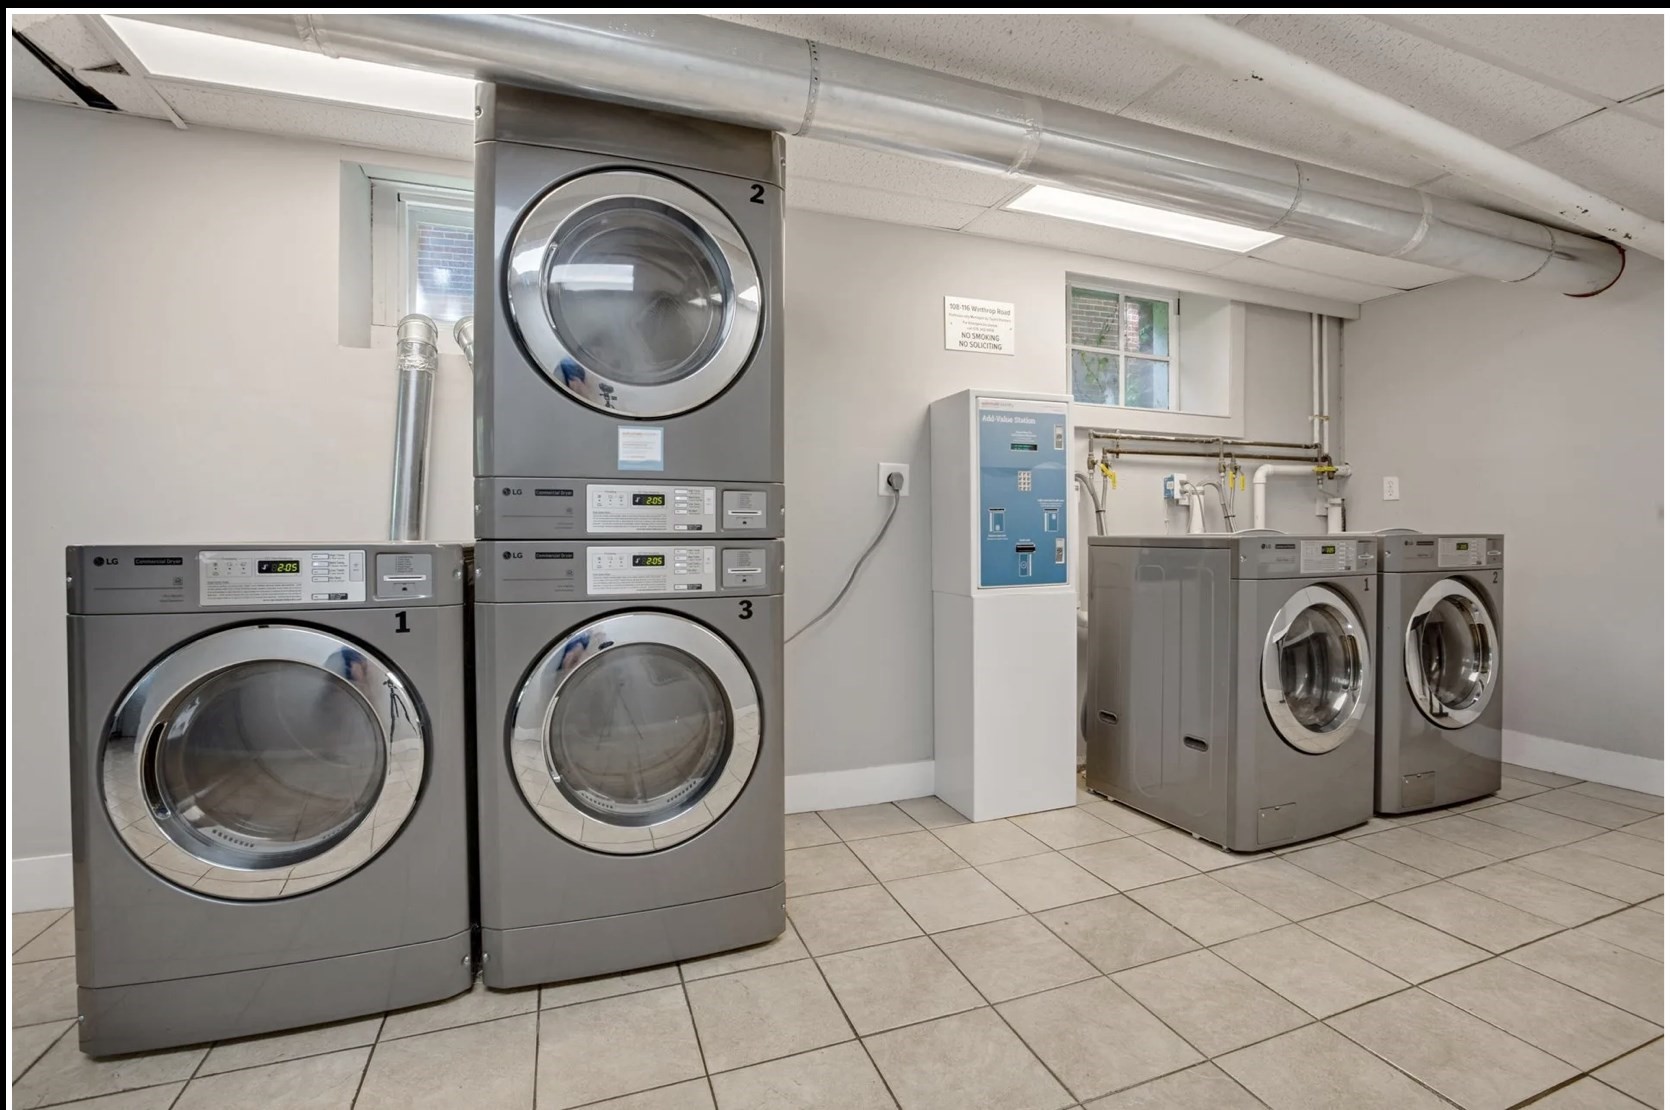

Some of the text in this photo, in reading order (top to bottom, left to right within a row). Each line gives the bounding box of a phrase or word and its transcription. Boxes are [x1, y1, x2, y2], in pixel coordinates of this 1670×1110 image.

[750, 183, 765, 205] 2
[997, 308, 1011, 316] Road
[971, 332, 1000, 342] SMOKING
[969, 341, 1002, 351] SOLICITING
[1014, 416, 1036, 425] Station
[106, 557, 119, 566] LG
[166, 558, 182, 566] Dryer
[1492, 571, 1499, 584] 2
[1363, 577, 1370, 592] 1
[738, 599, 753, 620] 3
[394, 610, 411, 633] 1
